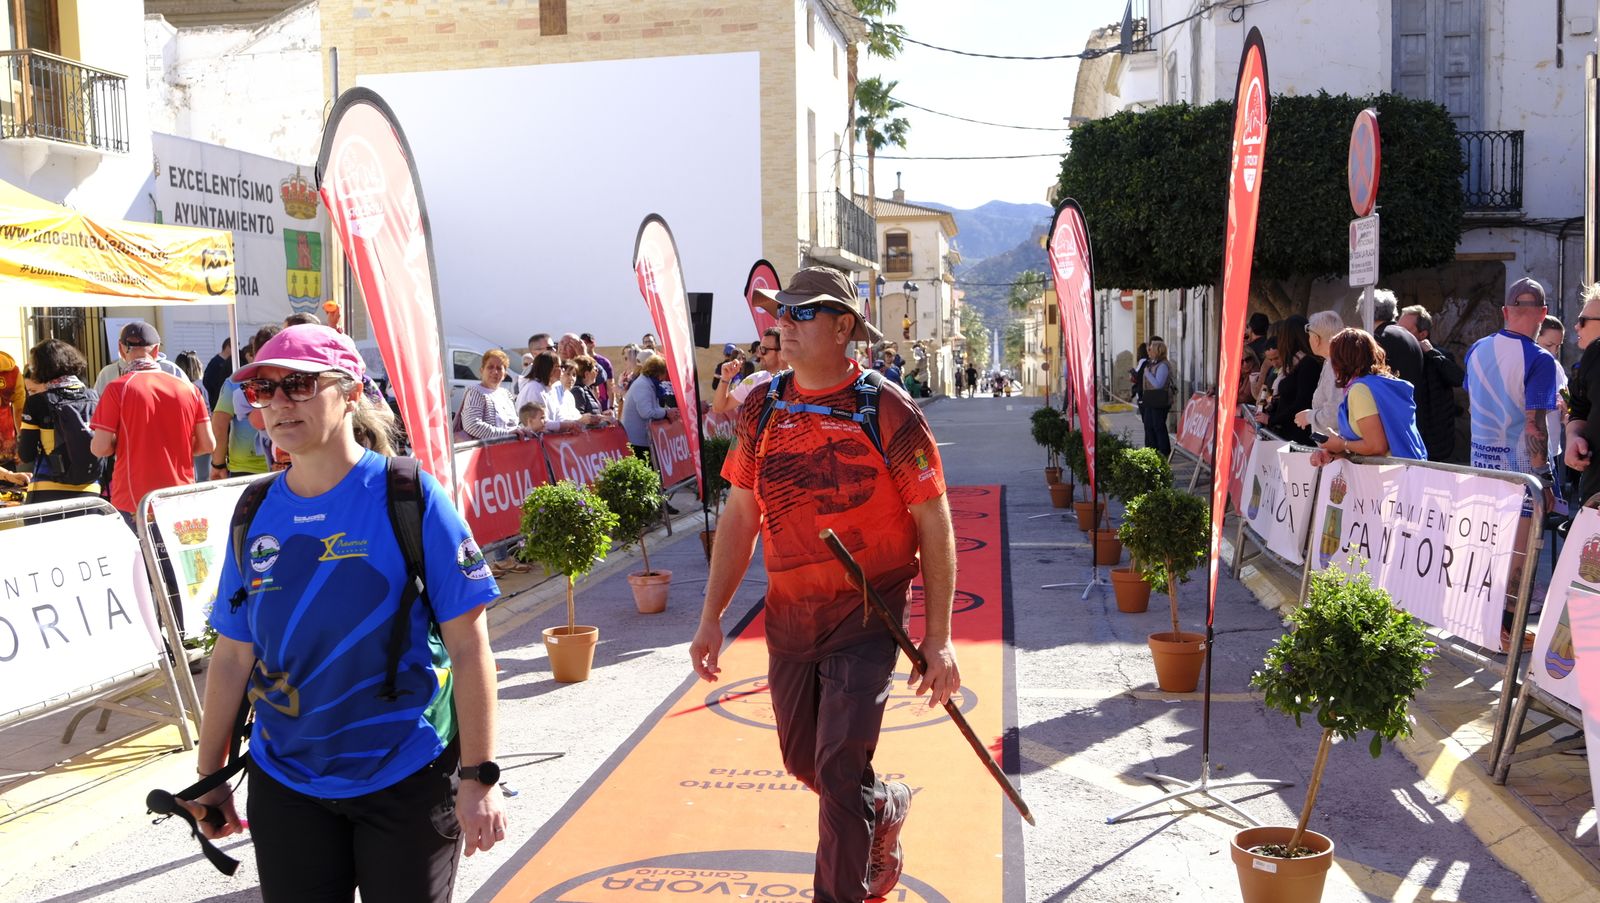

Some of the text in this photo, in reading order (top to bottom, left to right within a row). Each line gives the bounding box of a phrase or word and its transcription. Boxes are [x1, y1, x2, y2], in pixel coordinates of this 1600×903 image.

[168, 165, 273, 204] EXCELENTÍSIMO
[174, 202, 274, 235] AYUNTAMIENTO
[465, 469, 534, 519] VEOLIA
[1291, 482, 1310, 498] DE
[1480, 521, 1498, 546] DE
[78, 556, 112, 582] DE
[1342, 521, 1493, 602] CANTORIA
[679, 779, 810, 793] miento
[635, 869, 749, 881] Cantoria
